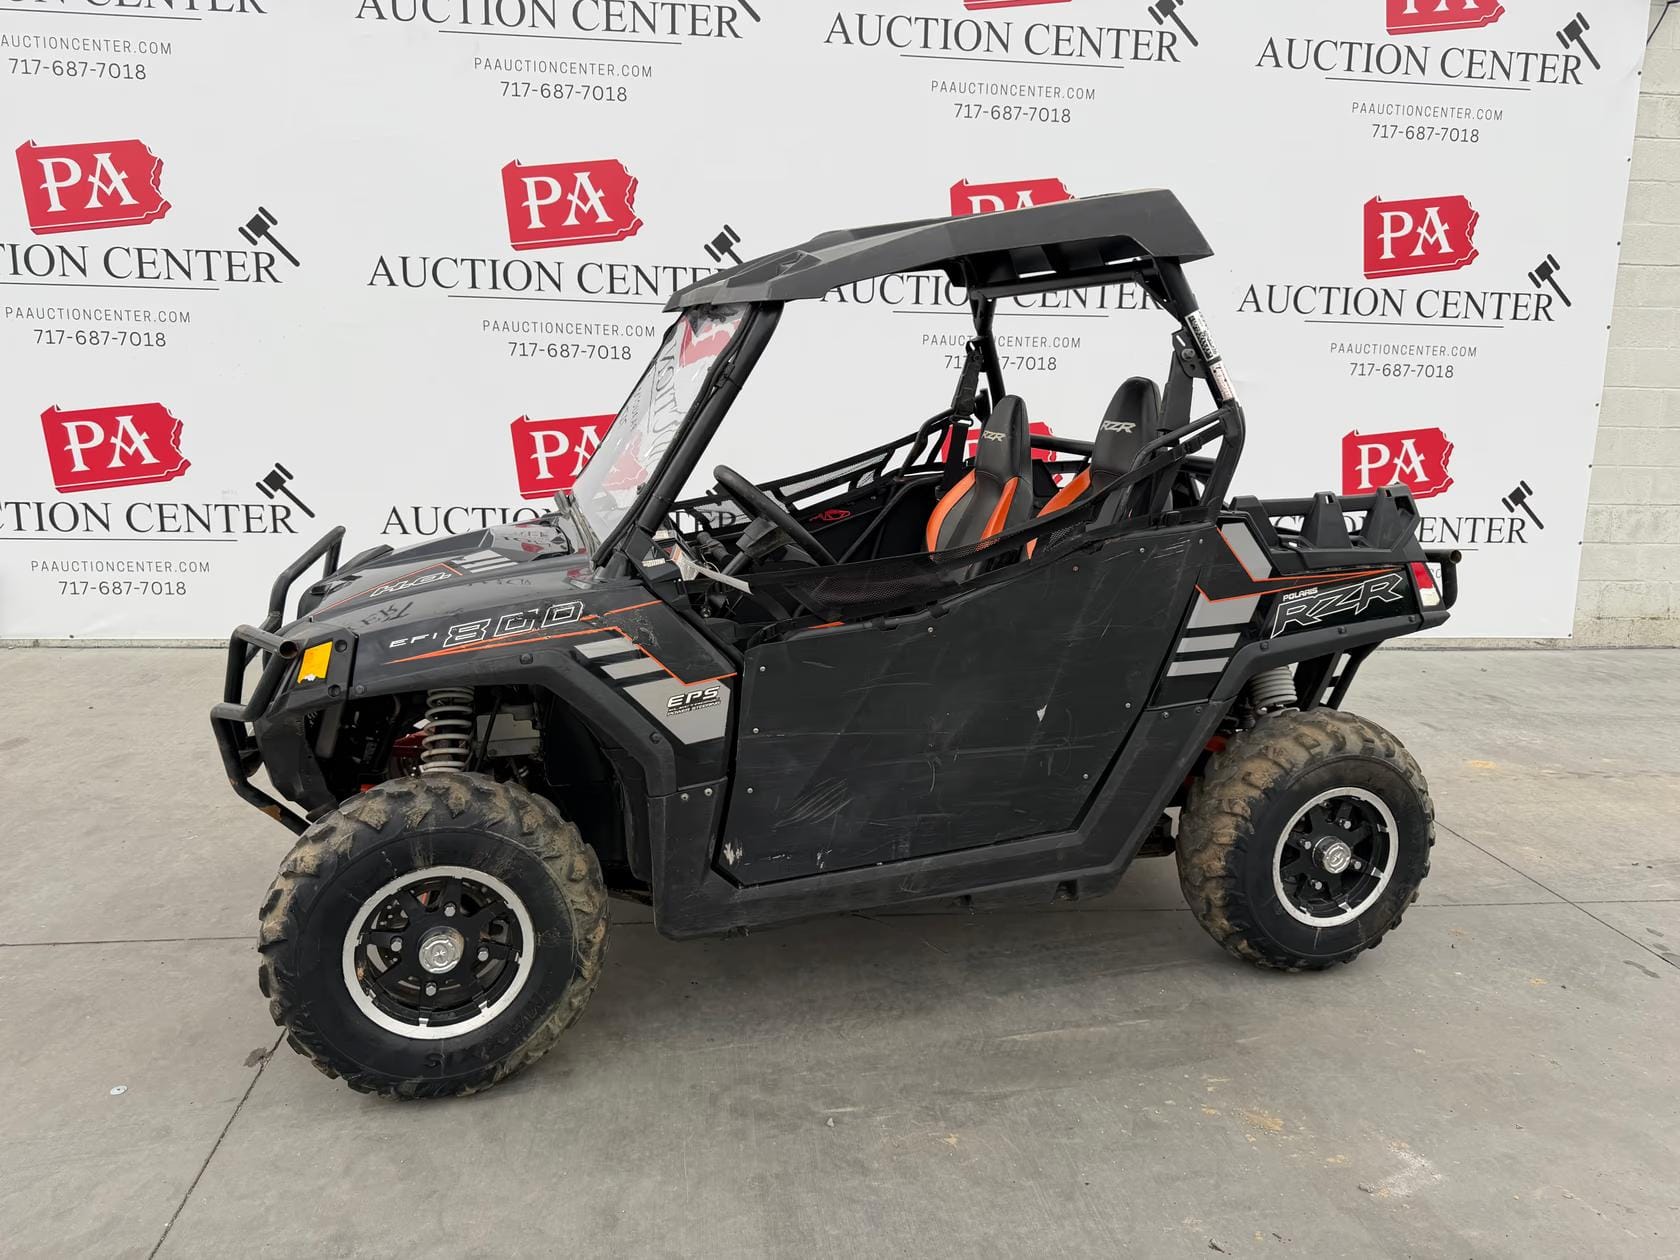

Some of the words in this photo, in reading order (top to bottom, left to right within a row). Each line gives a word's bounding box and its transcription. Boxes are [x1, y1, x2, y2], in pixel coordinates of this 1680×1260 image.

[355, 0, 555, 29] AUCTION
[571, 0, 743, 38] CENTER
[824, 12, 1011, 53] AUCTION
[1024, 23, 1181, 63] CENTER
[8, 58, 146, 81] 717-687-7018
[474, 57, 652, 78] PAAUCTIONCENTER.COM
[1256, 37, 1430, 77] AUCTION
[1439, 47, 1583, 85] CENTER
[500, 81, 627, 102] 717-687-7018
[931, 80, 1095, 100] PAAUCTIONCENTER.COM
[954, 103, 1071, 124] 717-687-7018
[1352, 102, 1503, 121] PAAUCTIONCENTER.COM
[1372, 123, 1480, 143] 717-687-7018
[37, 152, 140, 213] PA
[520, 171, 614, 230] PA
[1377, 206, 1455, 260] PA
[0, 243, 89, 278] ION
[103, 245, 283, 284] CENTER
[367, 255, 564, 292] AUCTION
[577, 262, 732, 296] CENT
[820, 274, 968, 306] AUCTIO
[5, 306, 191, 323] PAAUCTIONCENTER.COM
[1237, 284, 1406, 317] AUCTION
[1416, 289, 1555, 322] CENTER
[33, 329, 167, 348] 717-687-7018
[483, 319, 655, 337] PAAUCTIONCENTER.COM
[508, 341, 632, 361] 717-687-7018
[1330, 342, 1477, 357] PAAUCTIONCENTER.COM
[944, 355, 1057, 371] 717-7018
[1349, 362, 1454, 379] 717-687-7018
[1101, 420, 1136, 433] RZR
[61, 415, 160, 473] PA
[1354, 438, 1430, 489] PA
[0, 501, 112, 533] TION
[126, 502, 299, 534] CENTER
[1419, 516, 1529, 545] ENTER
[31, 560, 210, 573] PAAUCTIONCENTER.COM
[58, 580, 187, 596] 717-687-7018
[1283, 587, 1319, 601] POLARIS
[1270, 573, 1404, 639] RZR
[443, 601, 584, 648] 800
[667, 686, 721, 709] EPS
